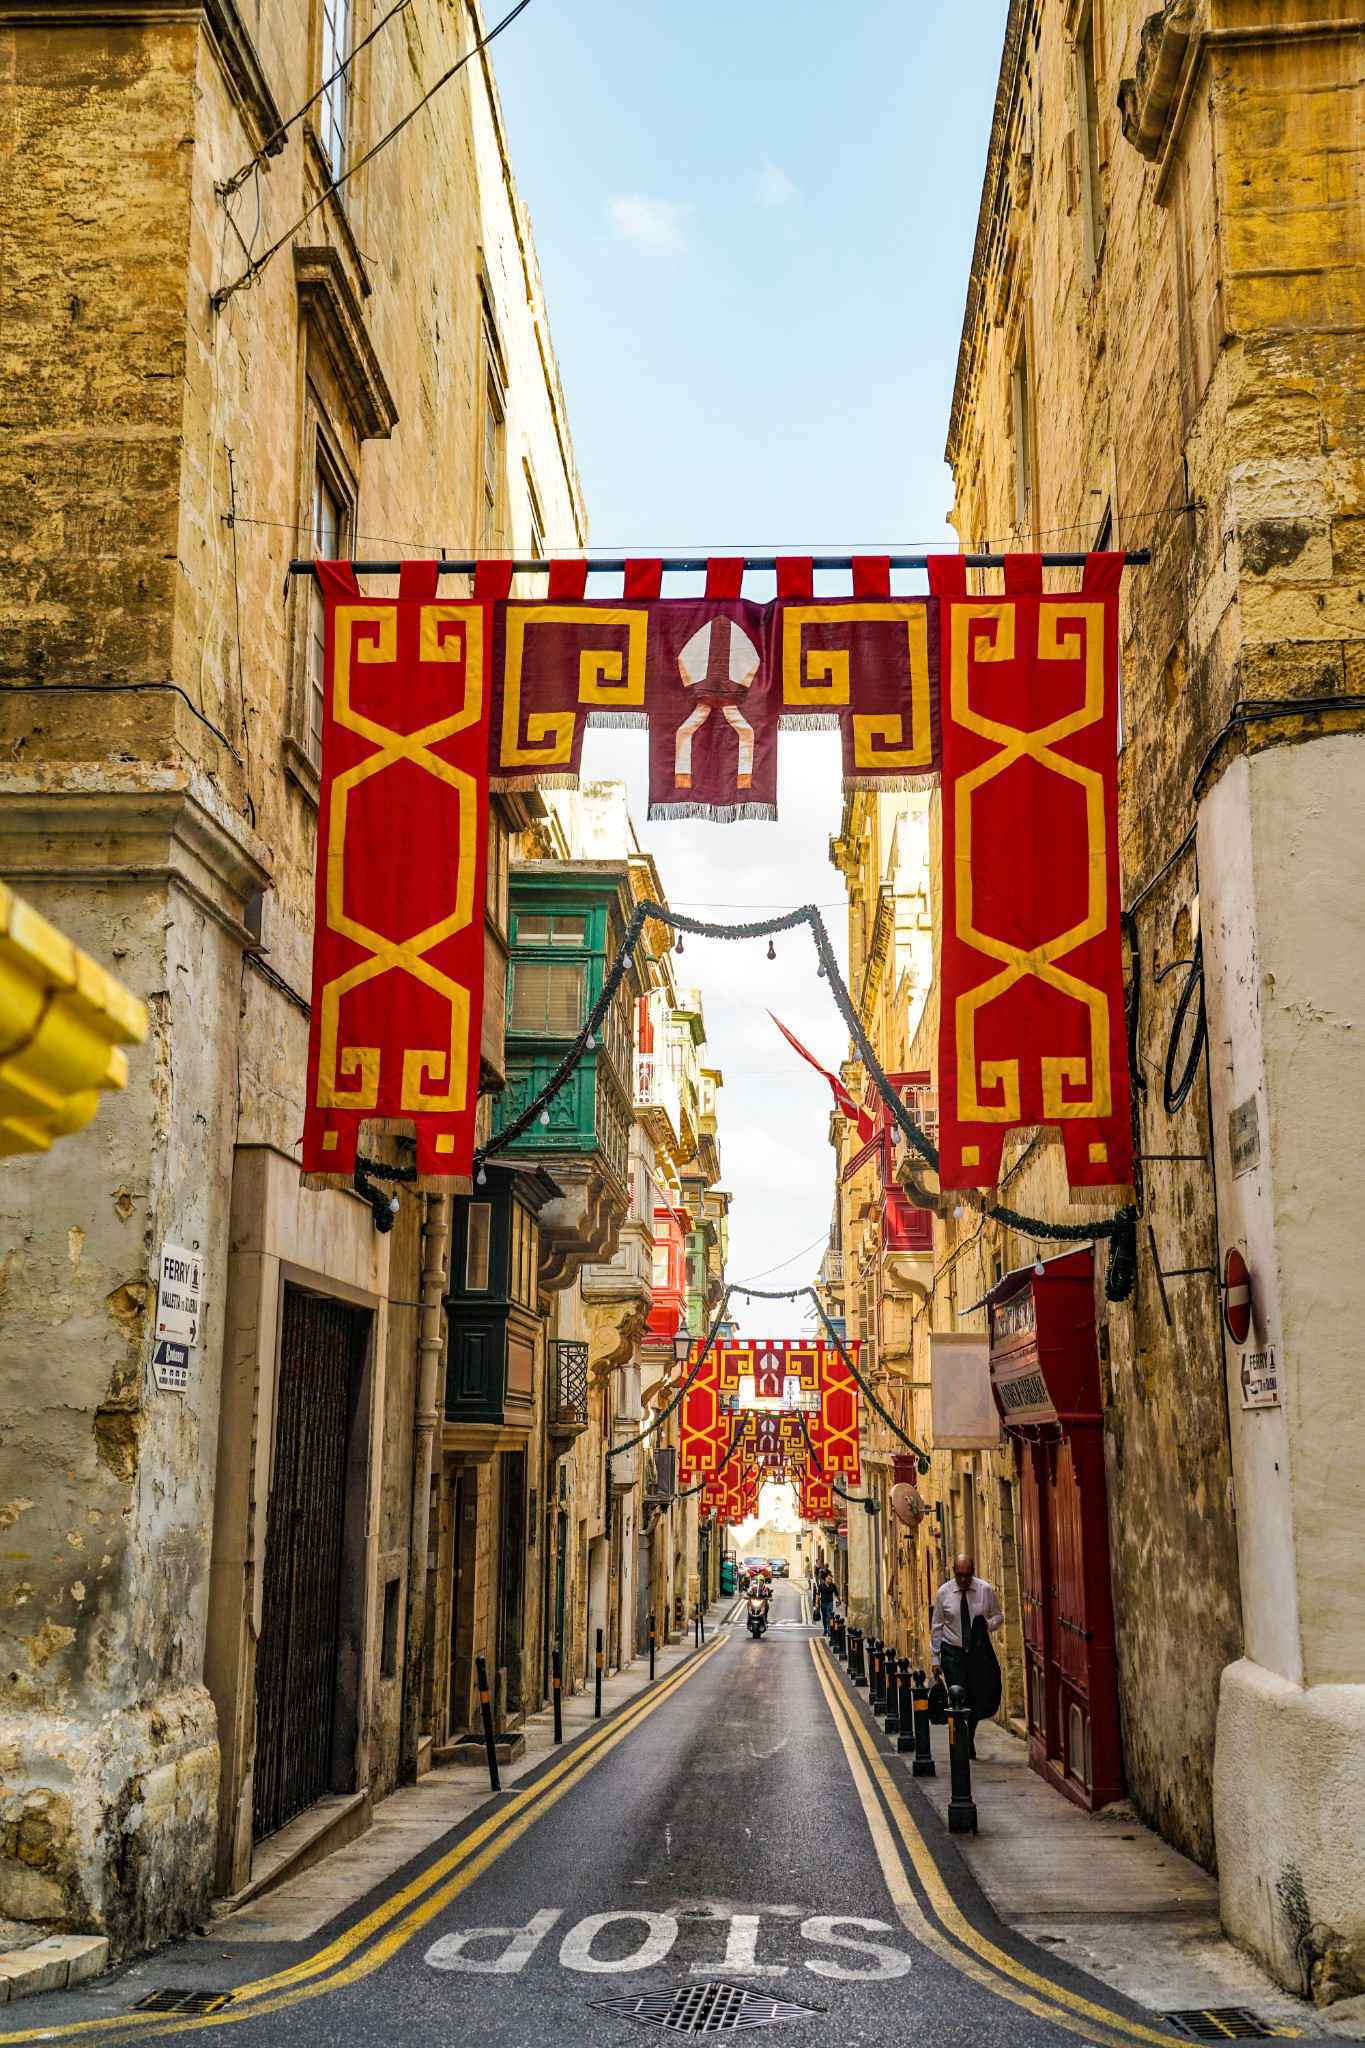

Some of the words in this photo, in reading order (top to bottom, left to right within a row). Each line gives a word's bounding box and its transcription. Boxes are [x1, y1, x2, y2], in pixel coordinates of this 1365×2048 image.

[163, 1256, 190, 1284] FERRY
[1249, 1352, 1268, 1370] FERRY
[424, 1908, 911, 1980] STOP
